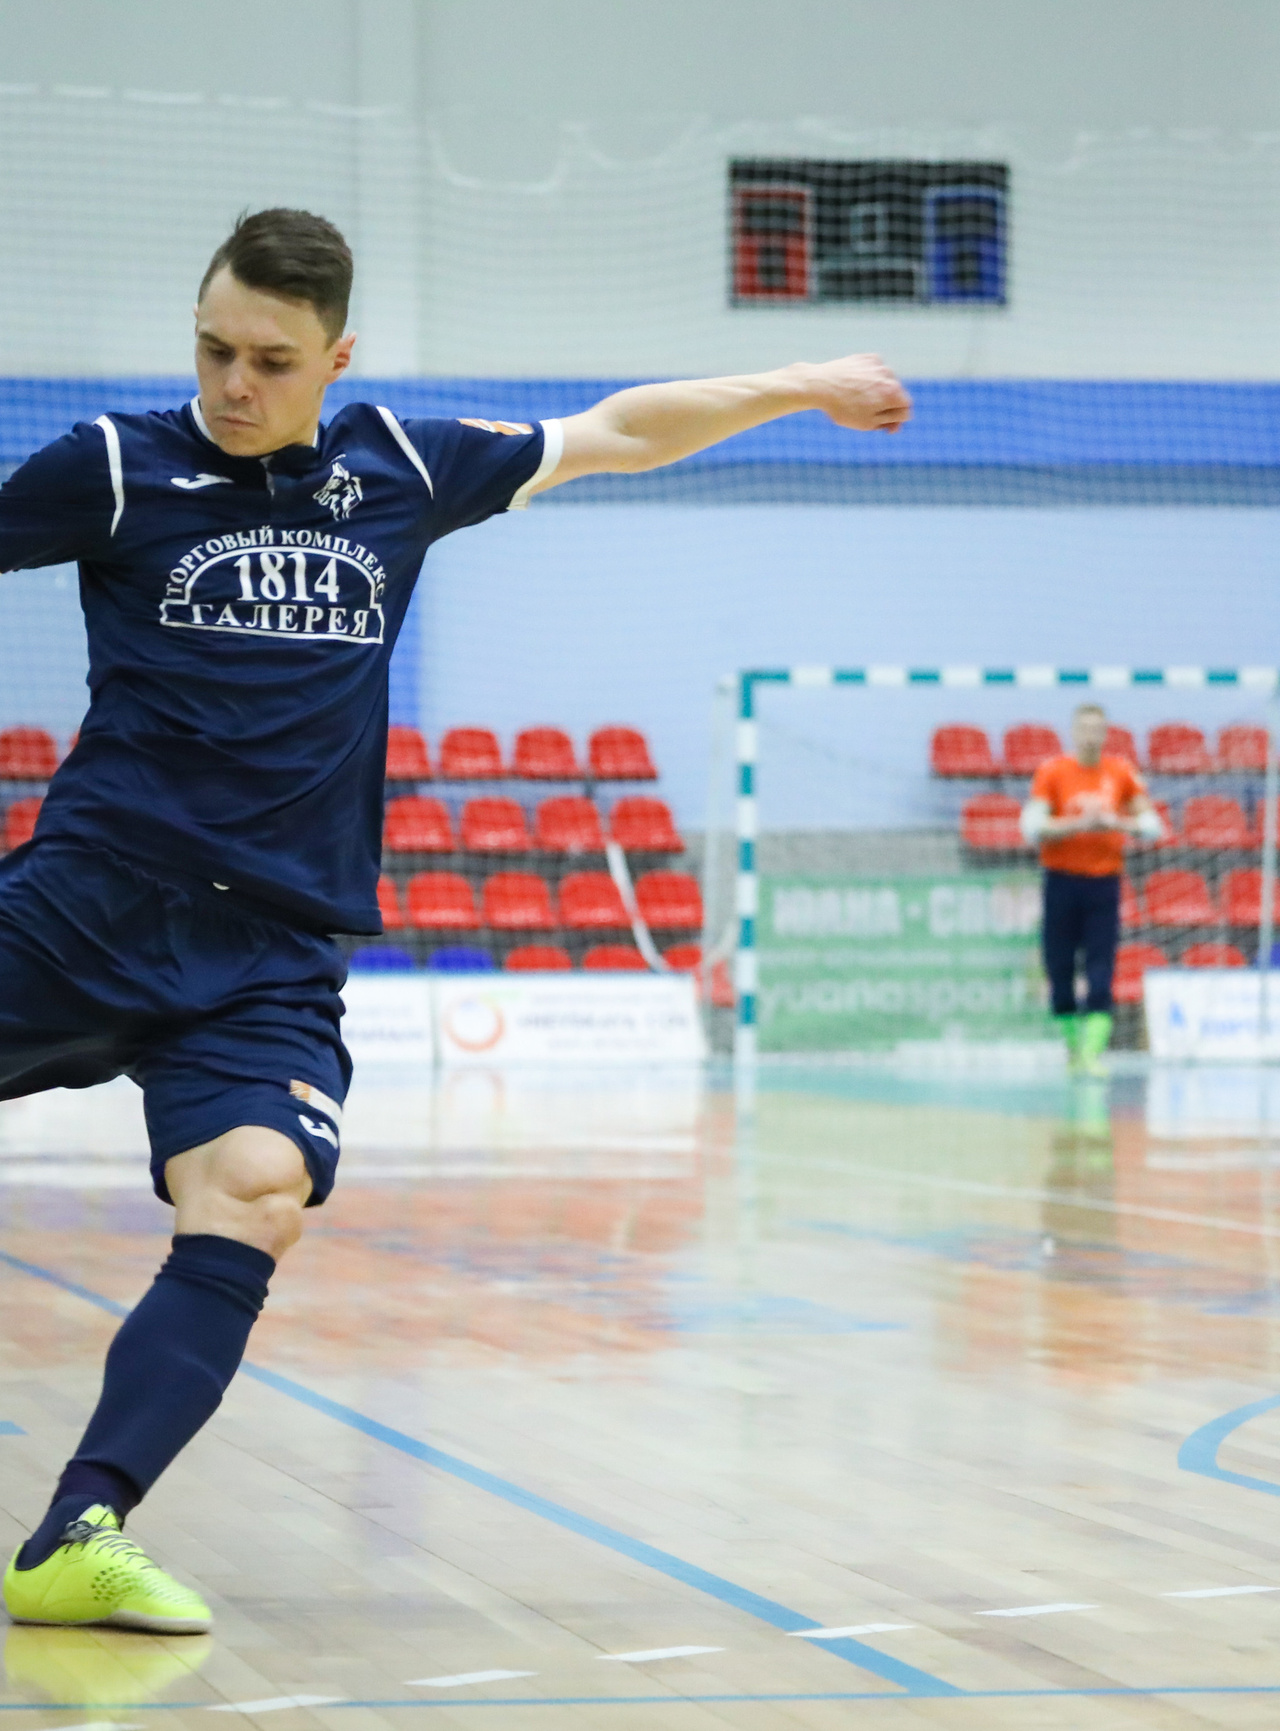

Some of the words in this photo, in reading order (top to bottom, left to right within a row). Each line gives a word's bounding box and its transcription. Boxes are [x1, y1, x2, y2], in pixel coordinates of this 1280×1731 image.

[166, 525, 274, 596] ТОРГОВЫЙ
[281, 529, 386, 598] КОМПЛЕКС
[233, 551, 340, 603] 1814
[190, 603, 370, 637] ГАЛЕРЕЯ
